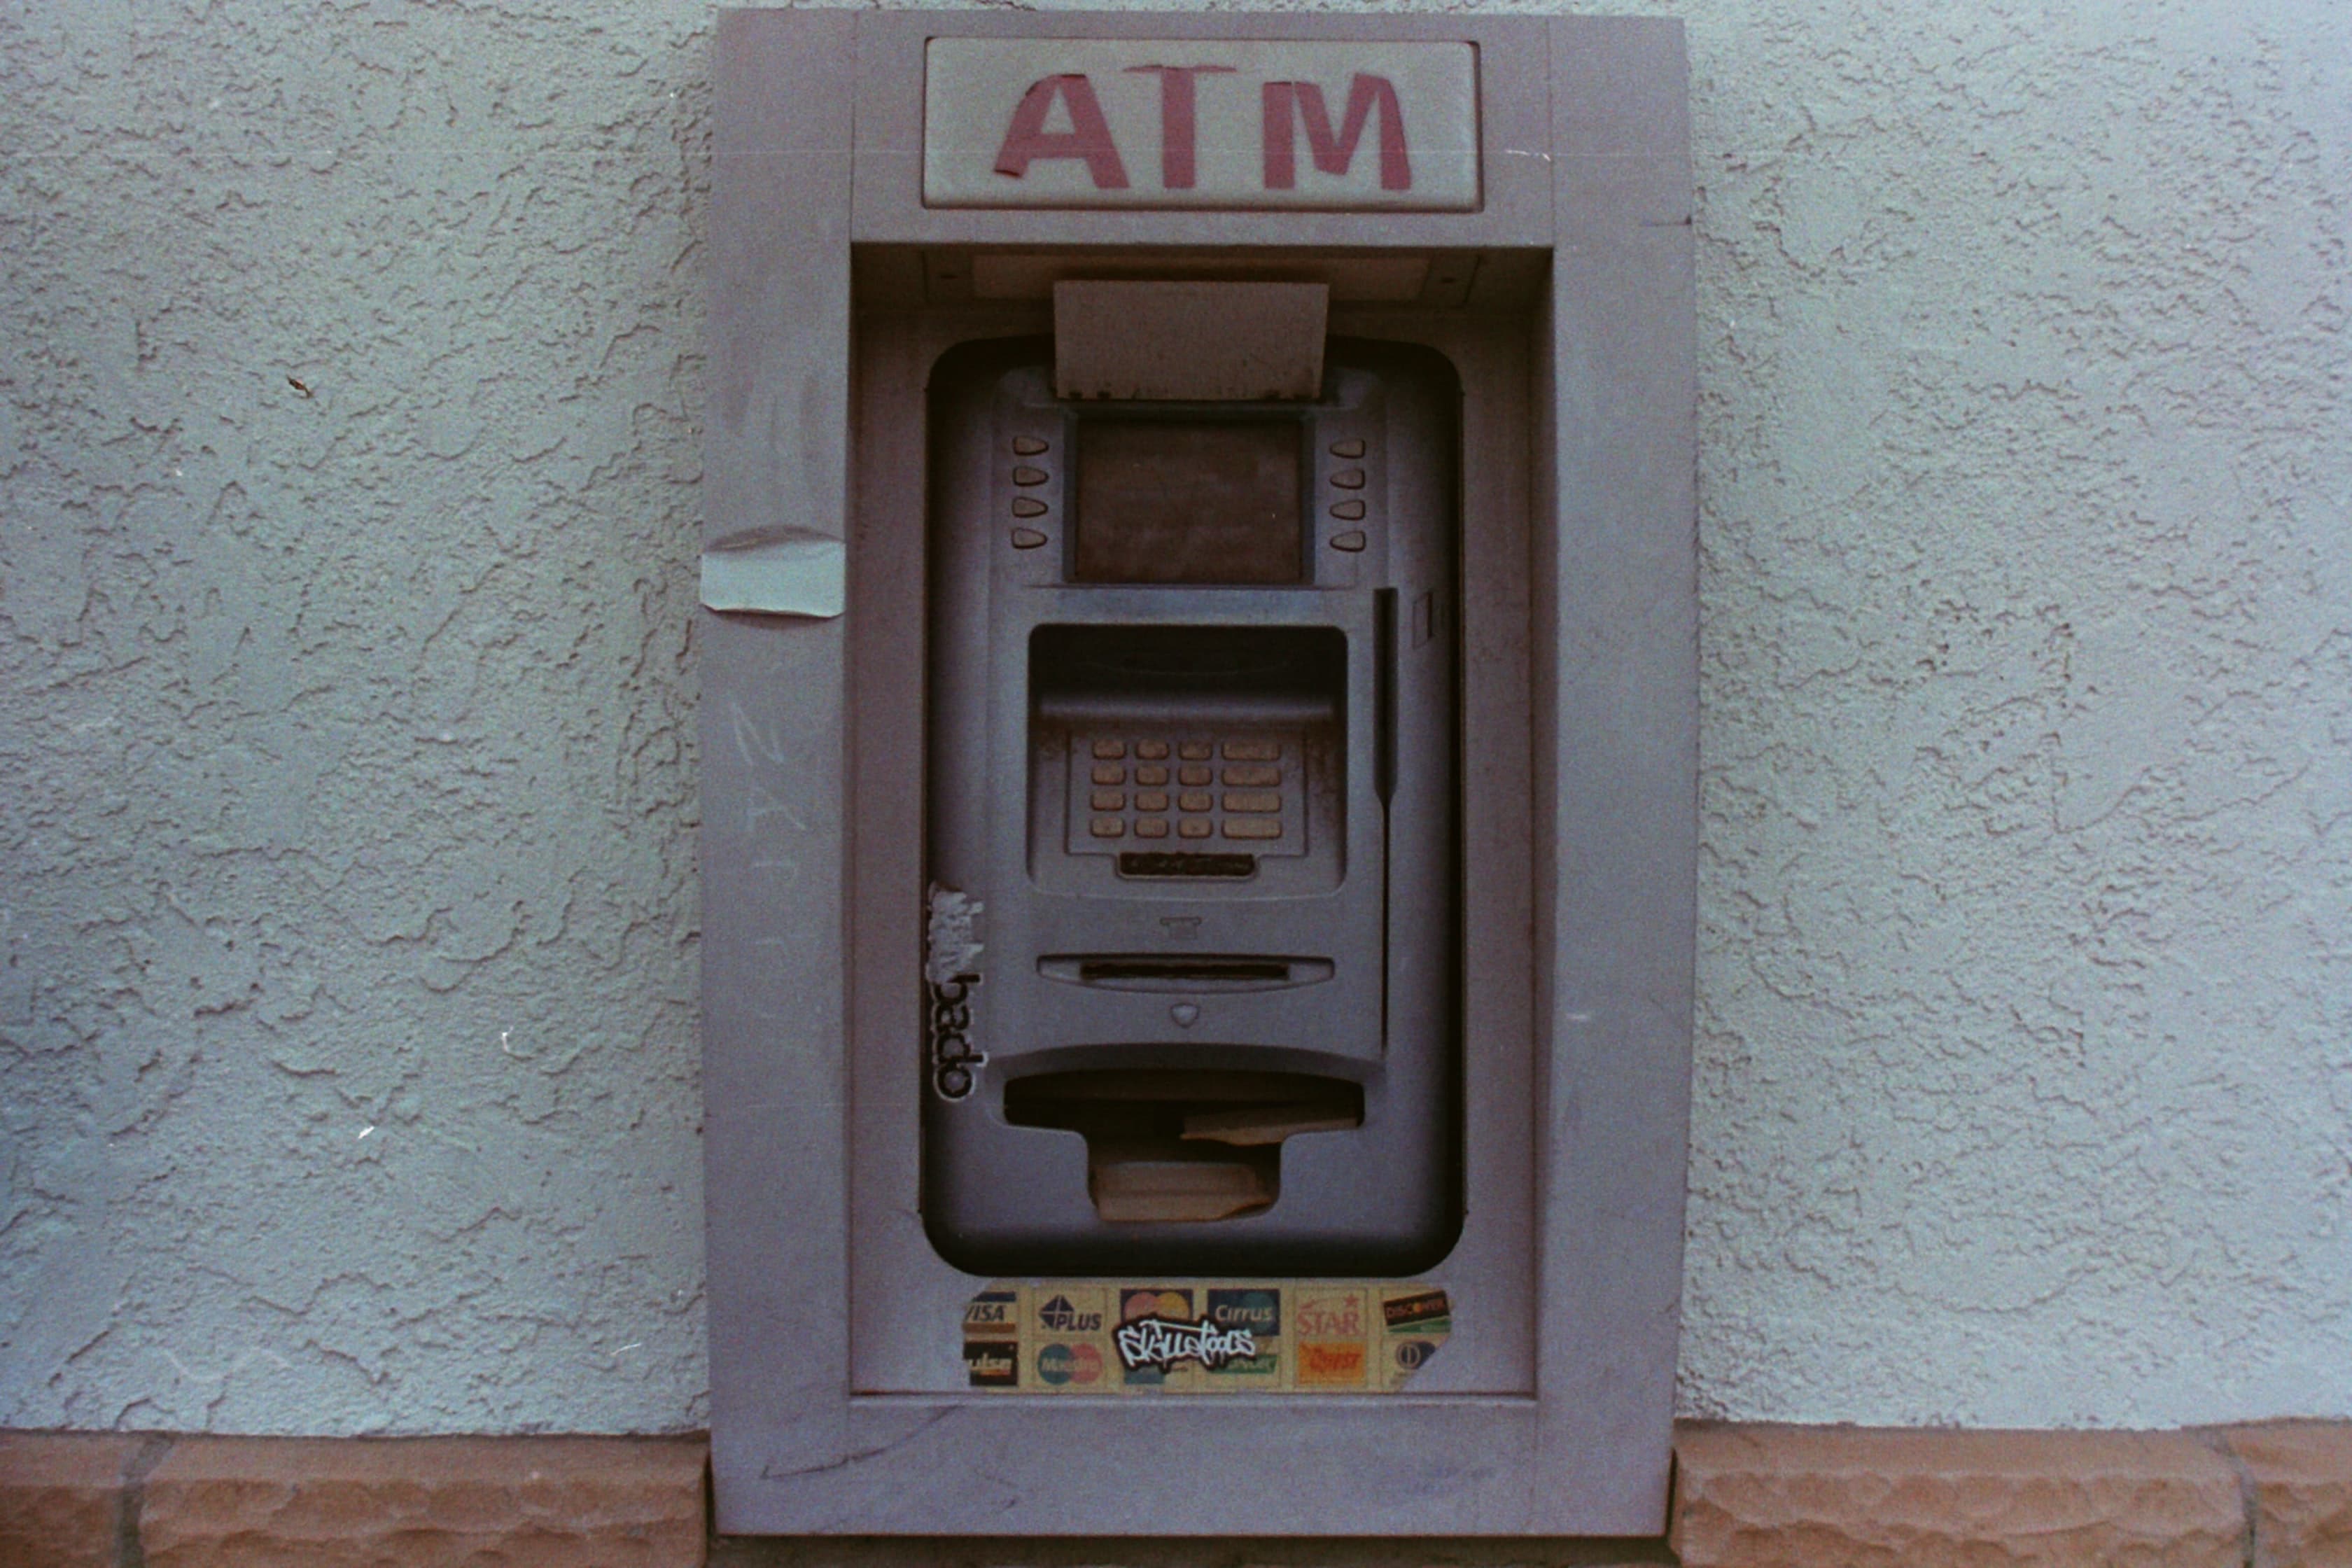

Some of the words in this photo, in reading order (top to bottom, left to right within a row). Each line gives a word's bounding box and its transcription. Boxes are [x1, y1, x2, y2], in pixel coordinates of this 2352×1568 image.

[993, 64, 1411, 191] ATM
[1056, 1313, 1102, 1331] PLUS
[1214, 1304, 1273, 1322] Cirrus
[1297, 1310, 1359, 1334] STAR
